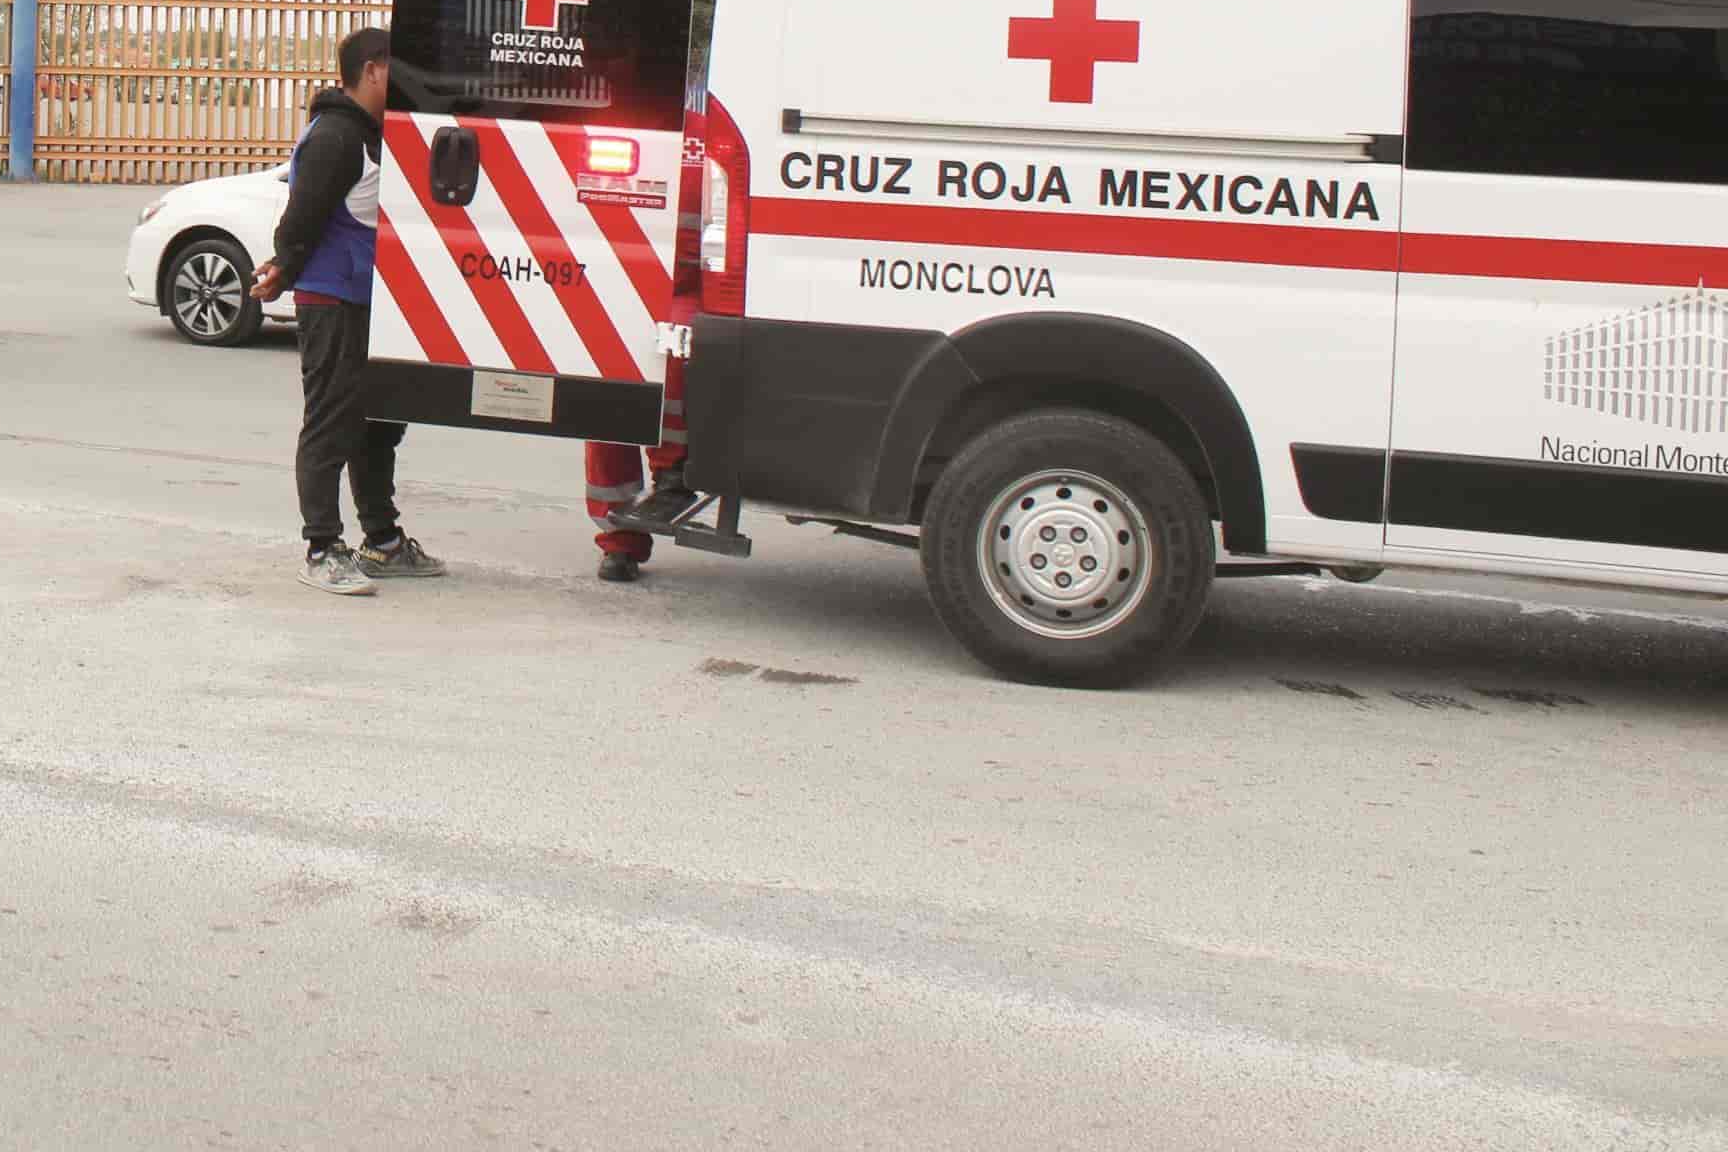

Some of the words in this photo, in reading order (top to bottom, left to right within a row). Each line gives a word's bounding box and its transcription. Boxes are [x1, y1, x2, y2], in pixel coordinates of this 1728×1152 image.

[491, 32, 537, 48] CRUZ
[540, 34, 585, 51] ROJA
[489, 49, 584, 69] MEXICANA
[779, 151, 913, 195] CRUZ
[937, 159, 1073, 204] ROJA
[1099, 168, 1381, 221] MEXICANA
[459, 252, 588, 287] COAH-097
[859, 257, 1057, 299] MONCLOVA
[1540, 435, 1649, 468] Nacional
